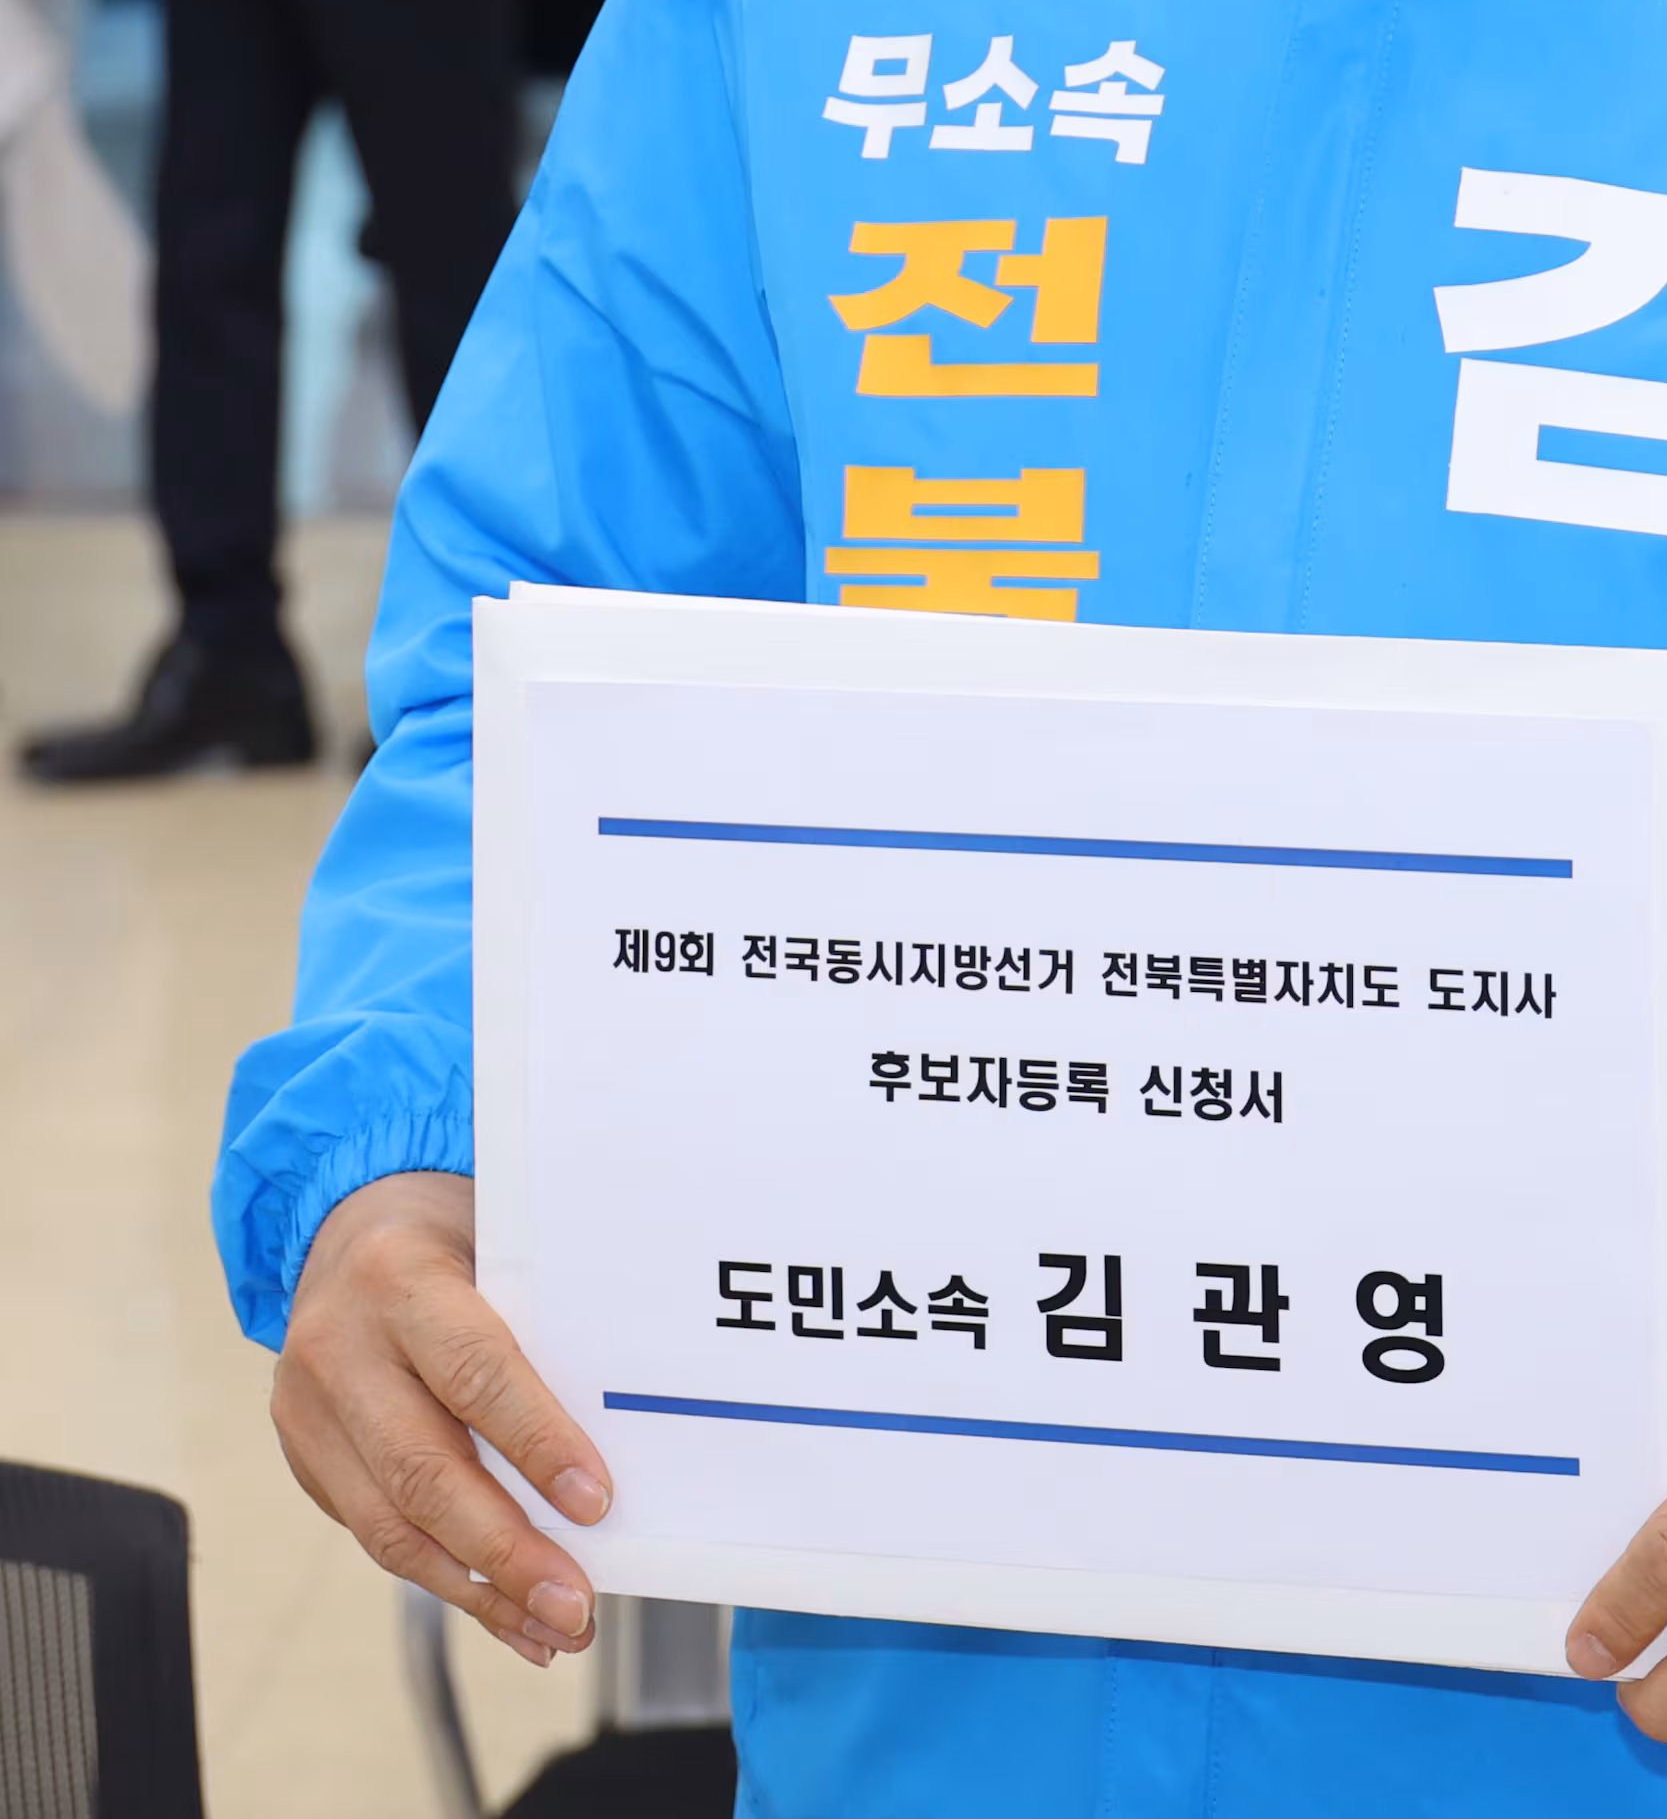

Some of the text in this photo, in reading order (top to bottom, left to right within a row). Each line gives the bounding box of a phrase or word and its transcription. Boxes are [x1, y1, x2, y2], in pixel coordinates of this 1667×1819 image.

[822, 34, 1165, 165] 무소속
[613, 928, 1557, 1019] 제9회 전국동시지방선거 전북특별자치도 도지사
[869, 1050, 1283, 1124] 후보자등록 신청서
[715, 1260, 990, 1351] 도민소속
